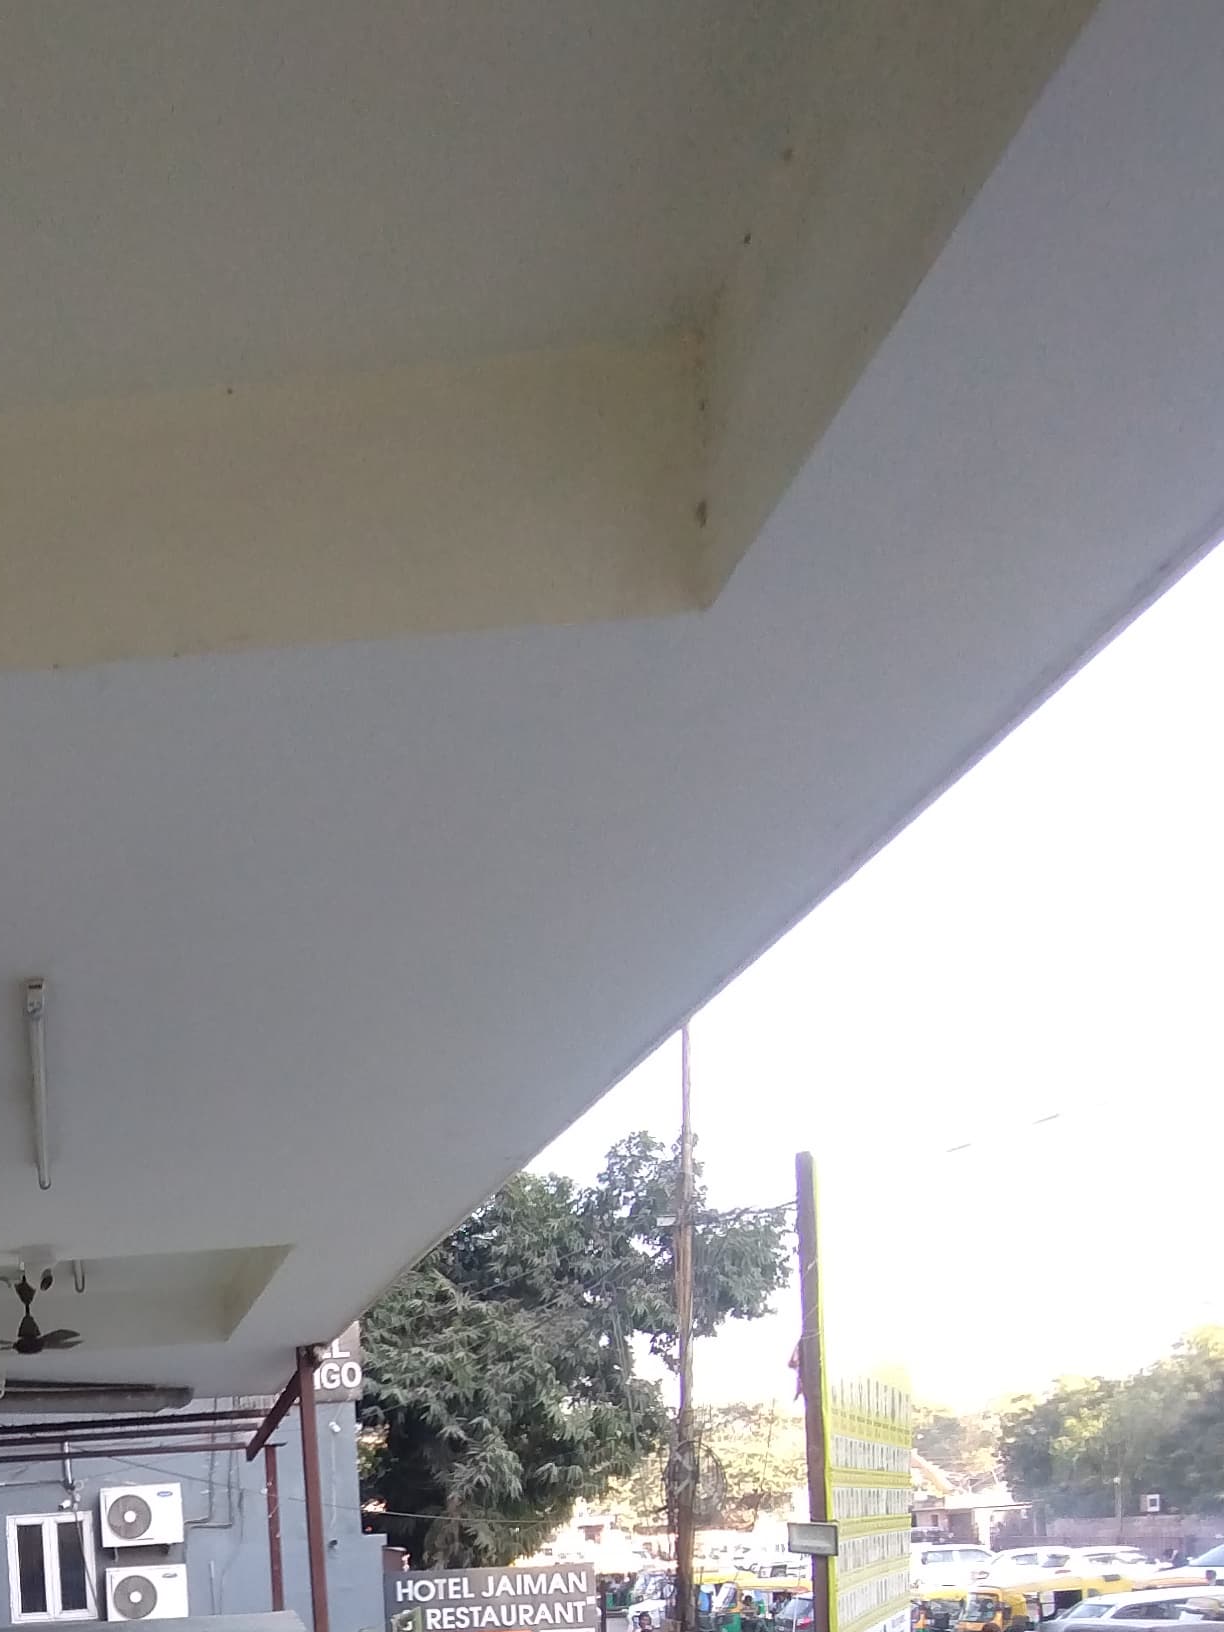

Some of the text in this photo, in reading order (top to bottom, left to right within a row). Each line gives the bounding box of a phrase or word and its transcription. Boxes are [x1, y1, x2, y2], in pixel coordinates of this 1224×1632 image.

[396, 1571, 587, 1602] HOTEL JAIMAN
[427, 1601, 586, 1630] RESTAURANT
